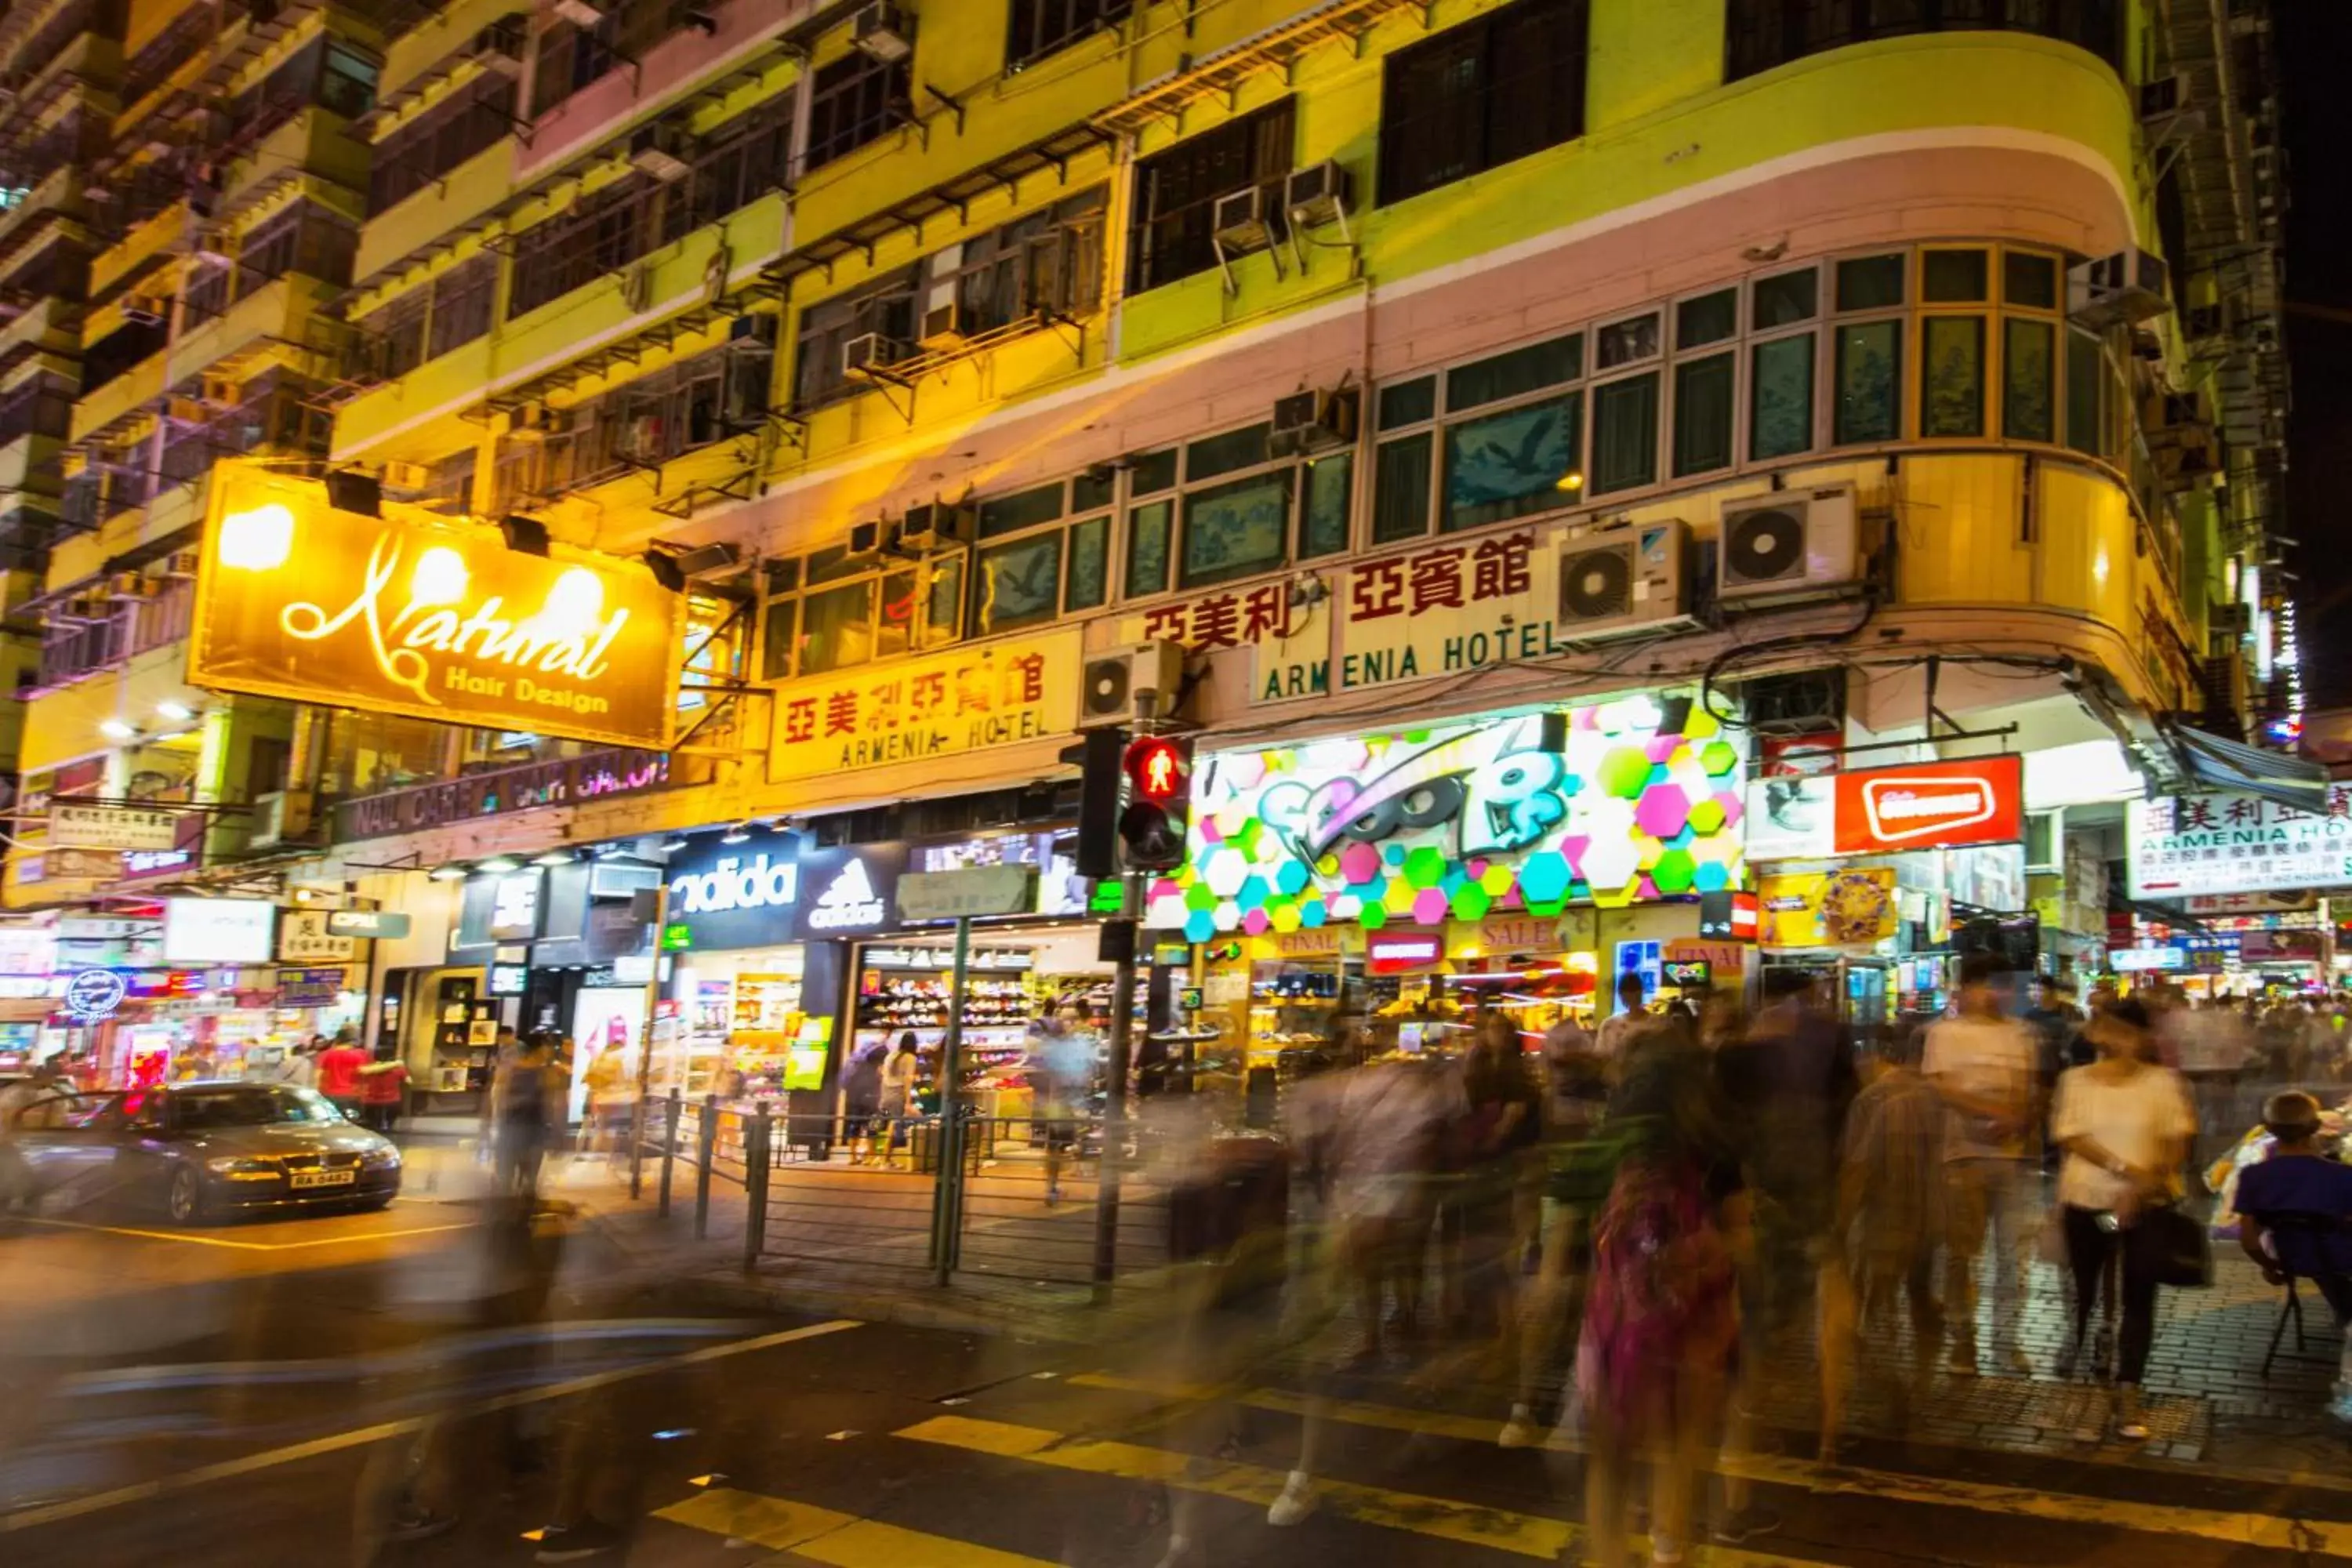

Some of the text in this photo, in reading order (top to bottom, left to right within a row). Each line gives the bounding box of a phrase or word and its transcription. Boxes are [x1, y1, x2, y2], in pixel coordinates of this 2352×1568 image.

[281, 530, 631, 704] Natural
[1145, 533, 1536, 655] 亞美利 亞賓館
[1444, 621, 1563, 671] HOTEL
[445, 666, 609, 713] Hair Design
[840, 708, 1049, 768] ARMENIA HOTEL
[355, 798, 398, 834] NAIL
[410, 784, 470, 823] CARE
[2140, 827, 2288, 851] ARMENIA
[1281, 919, 1550, 952] FINAL SALE
